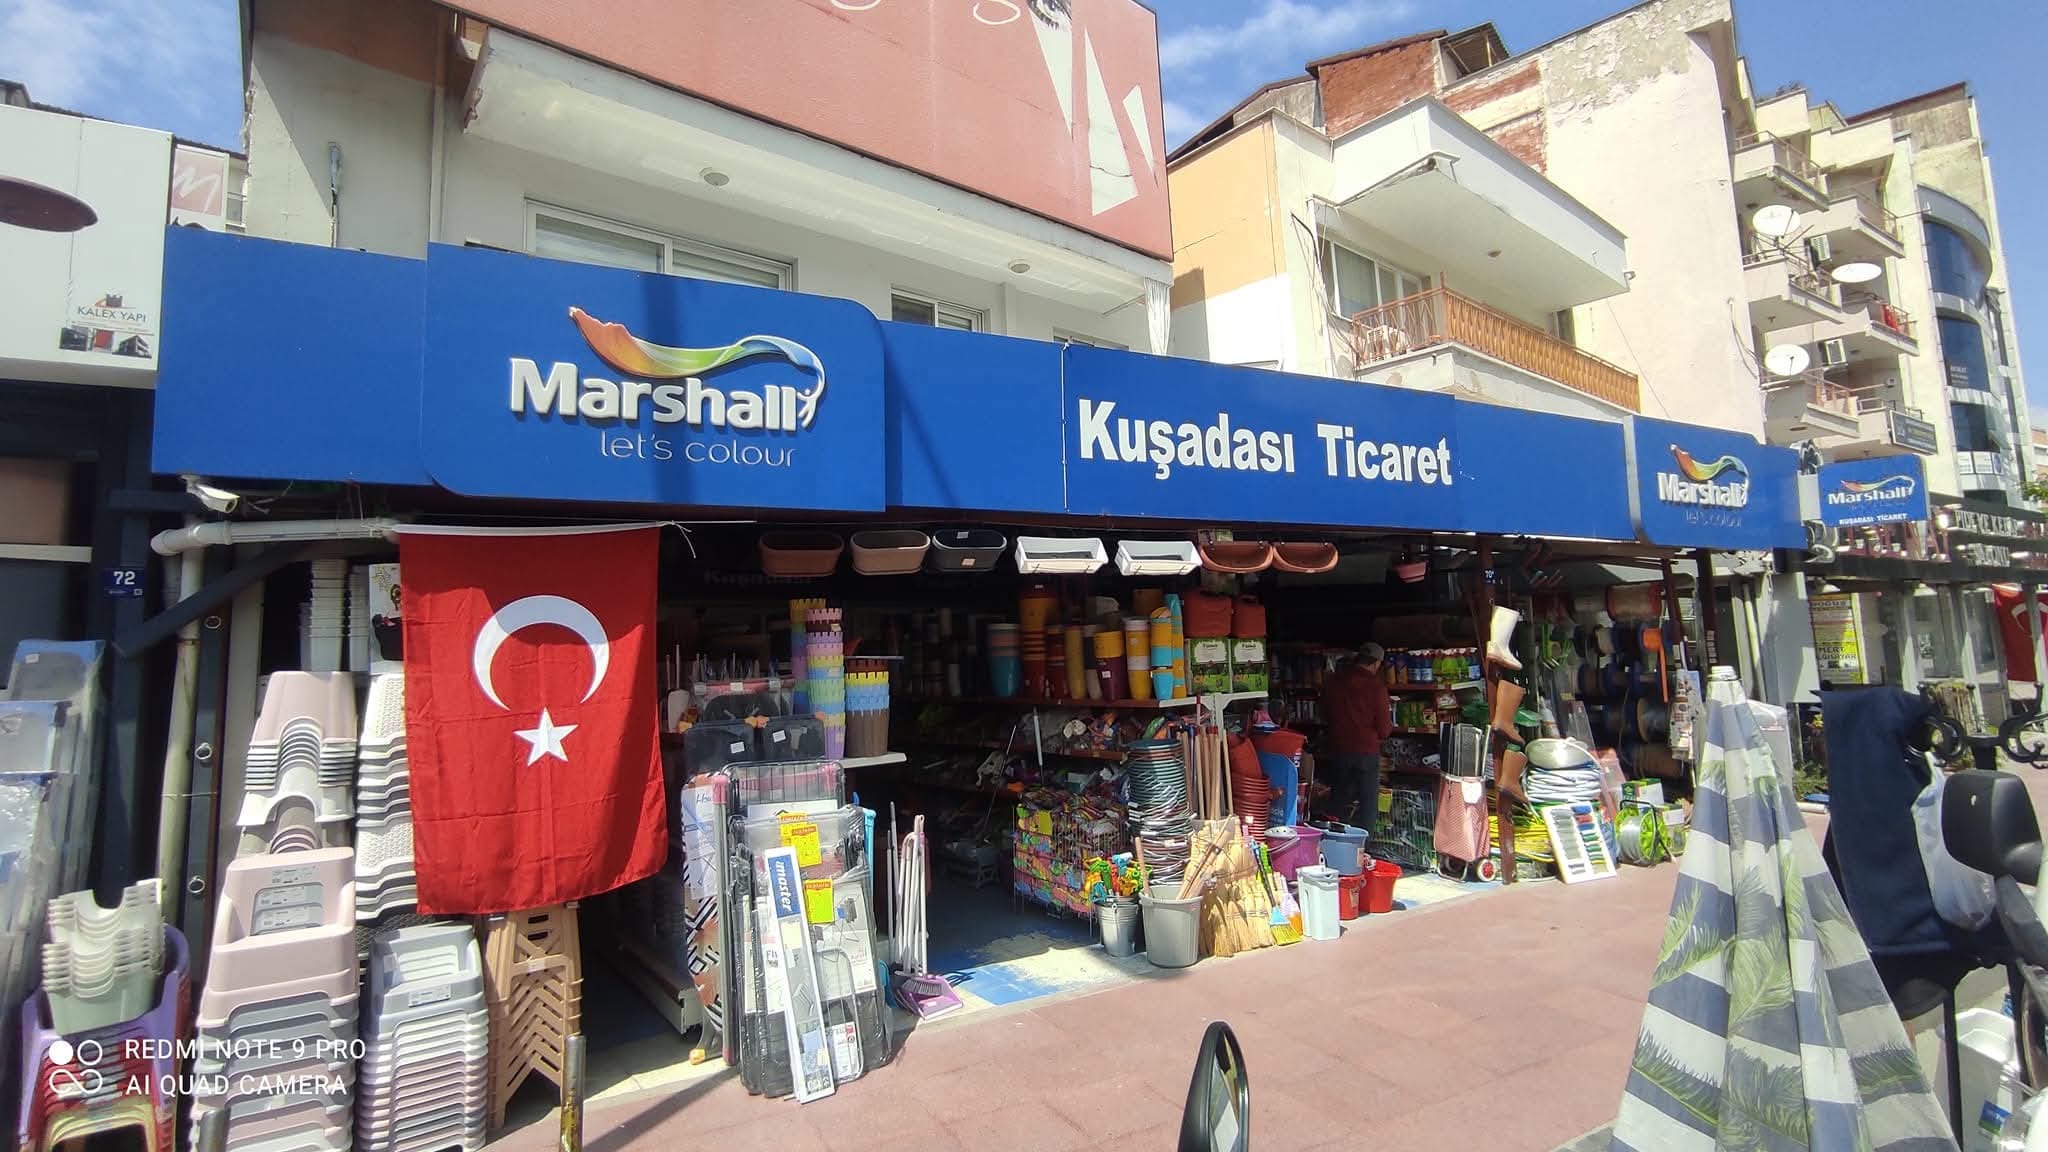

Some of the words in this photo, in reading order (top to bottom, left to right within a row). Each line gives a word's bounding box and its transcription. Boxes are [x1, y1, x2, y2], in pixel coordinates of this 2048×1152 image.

[77, 306, 116, 319] KALEX
[120, 311, 146, 323] YAPI
[510, 358, 797, 432] Marshall
[600, 430, 673, 460] let's
[685, 439, 796, 467] colour
[1078, 398, 1295, 480] Kuşadası
[1317, 423, 1452, 486] Ticaret
[1657, 472, 1745, 508] Marshall
[1828, 486, 1909, 505] Marshall
[113, 571, 136, 585] 72
[775, 860, 794, 912] master
